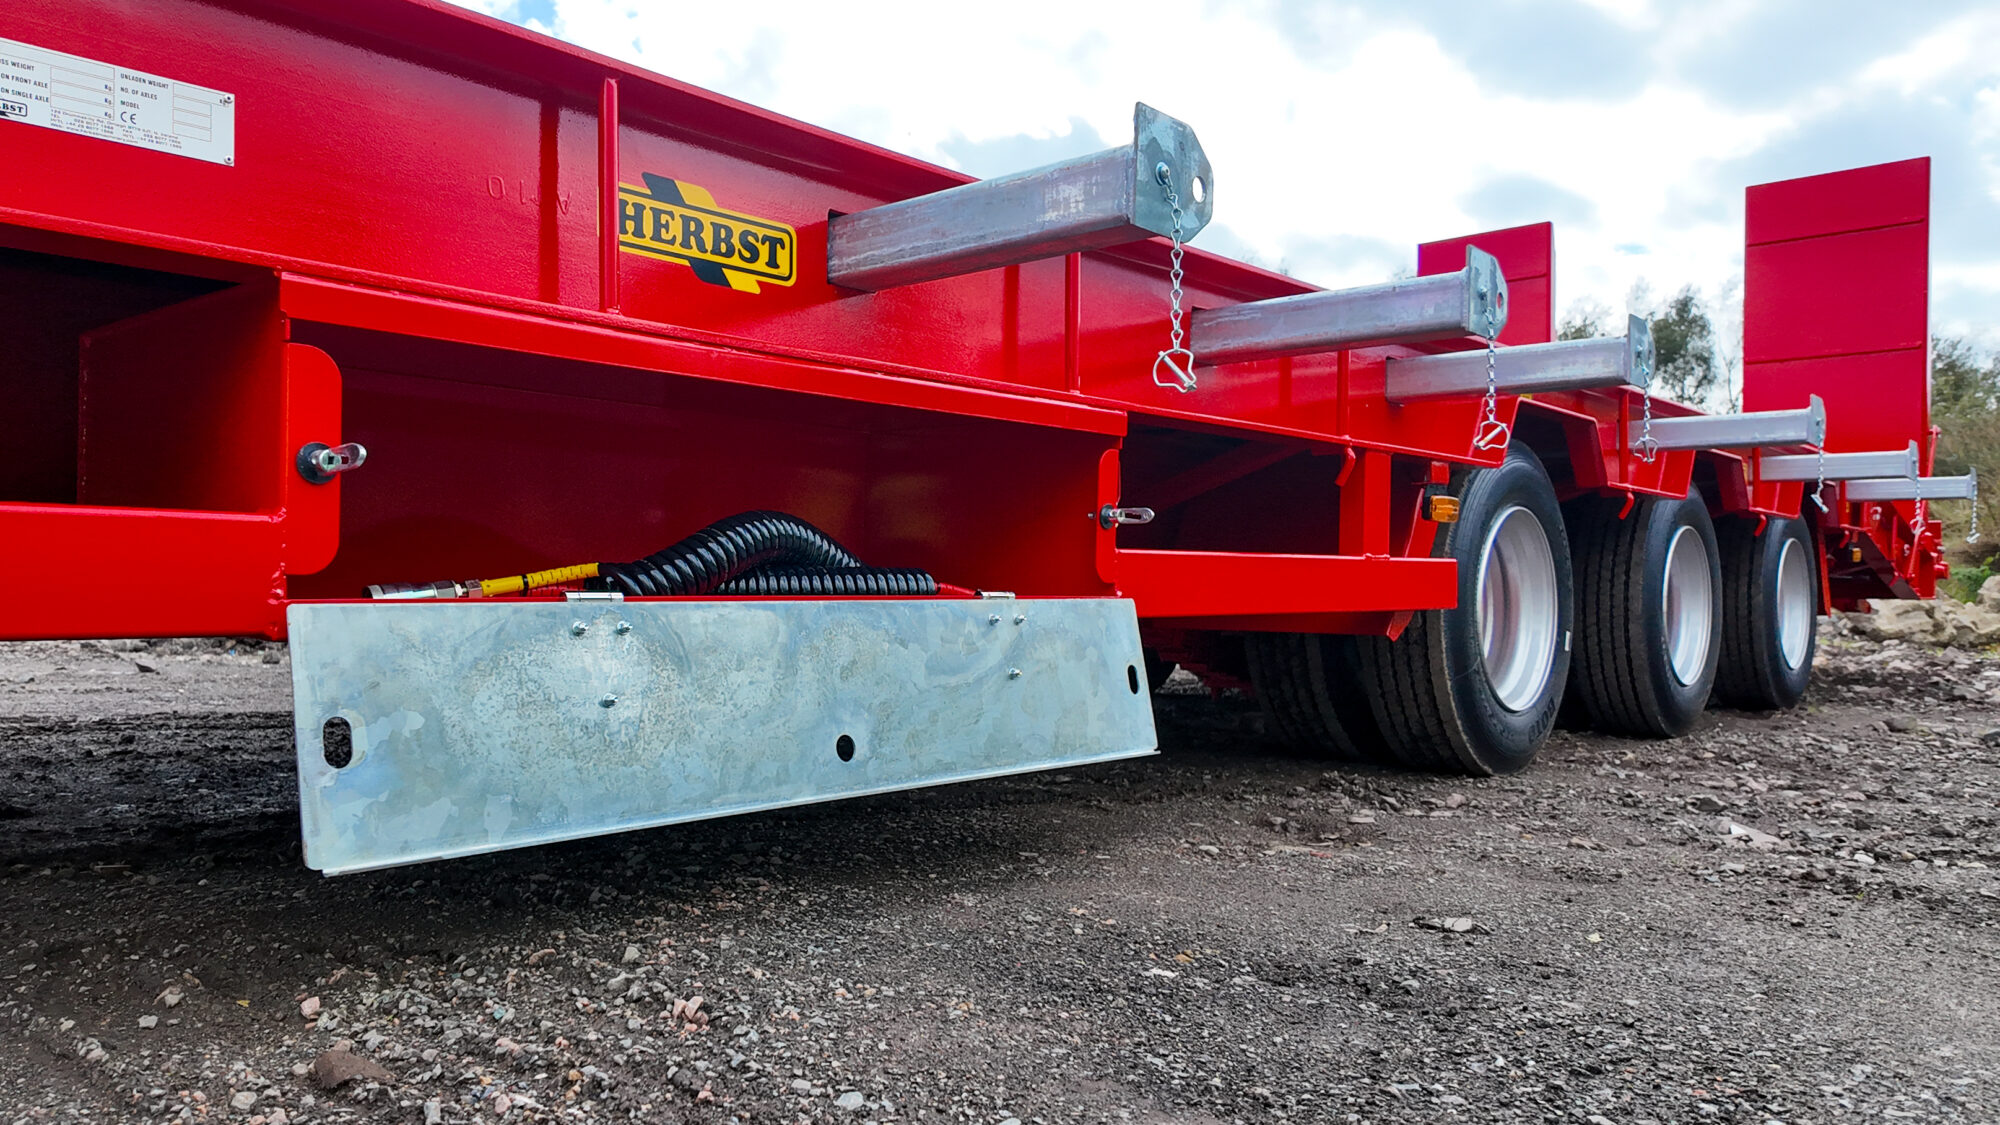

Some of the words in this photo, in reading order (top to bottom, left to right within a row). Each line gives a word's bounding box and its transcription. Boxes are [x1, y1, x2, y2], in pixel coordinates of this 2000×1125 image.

[11, 60, 35, 72] WEIGHT
[0, 72, 10, 80] ON
[11, 75, 32, 85] FRONT
[33, 80, 49, 89] AXLE
[120, 73, 147, 84] UNLADEN
[147, 79, 169, 89] WEIGHT
[11, 89, 33, 100] SINGLE
[34, 94, 49, 103] AXLE
[140, 90, 158, 101] AXLES
[0, 102, 24, 113] BST
[120, 100, 140, 110] MODEL
[618, 198, 786, 270] HERBST
